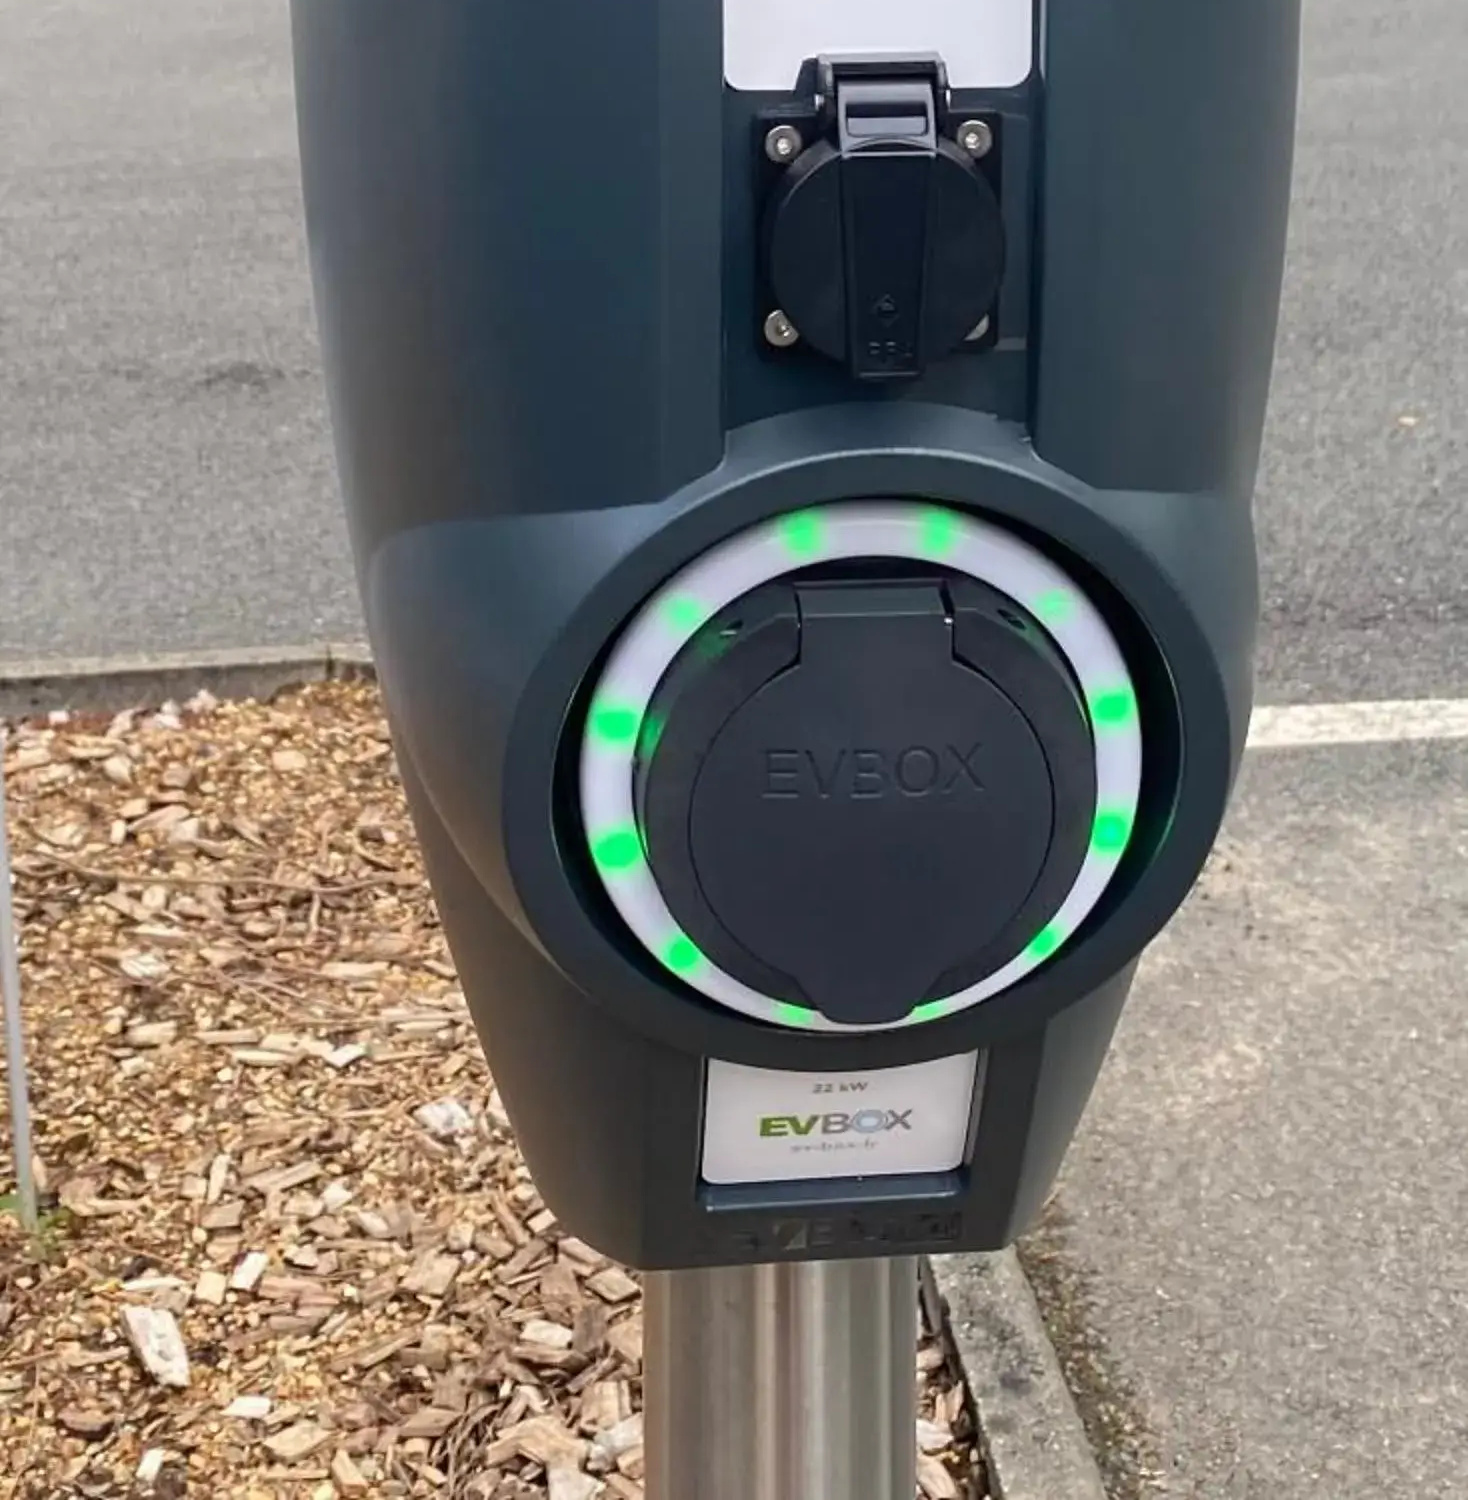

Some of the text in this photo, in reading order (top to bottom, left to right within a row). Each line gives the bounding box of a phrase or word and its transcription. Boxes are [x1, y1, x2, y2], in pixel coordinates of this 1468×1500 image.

[761, 742, 986, 799] EVBOX
[812, 1081, 869, 1094] 22 kW
[759, 1108, 914, 1138] EVBOX
